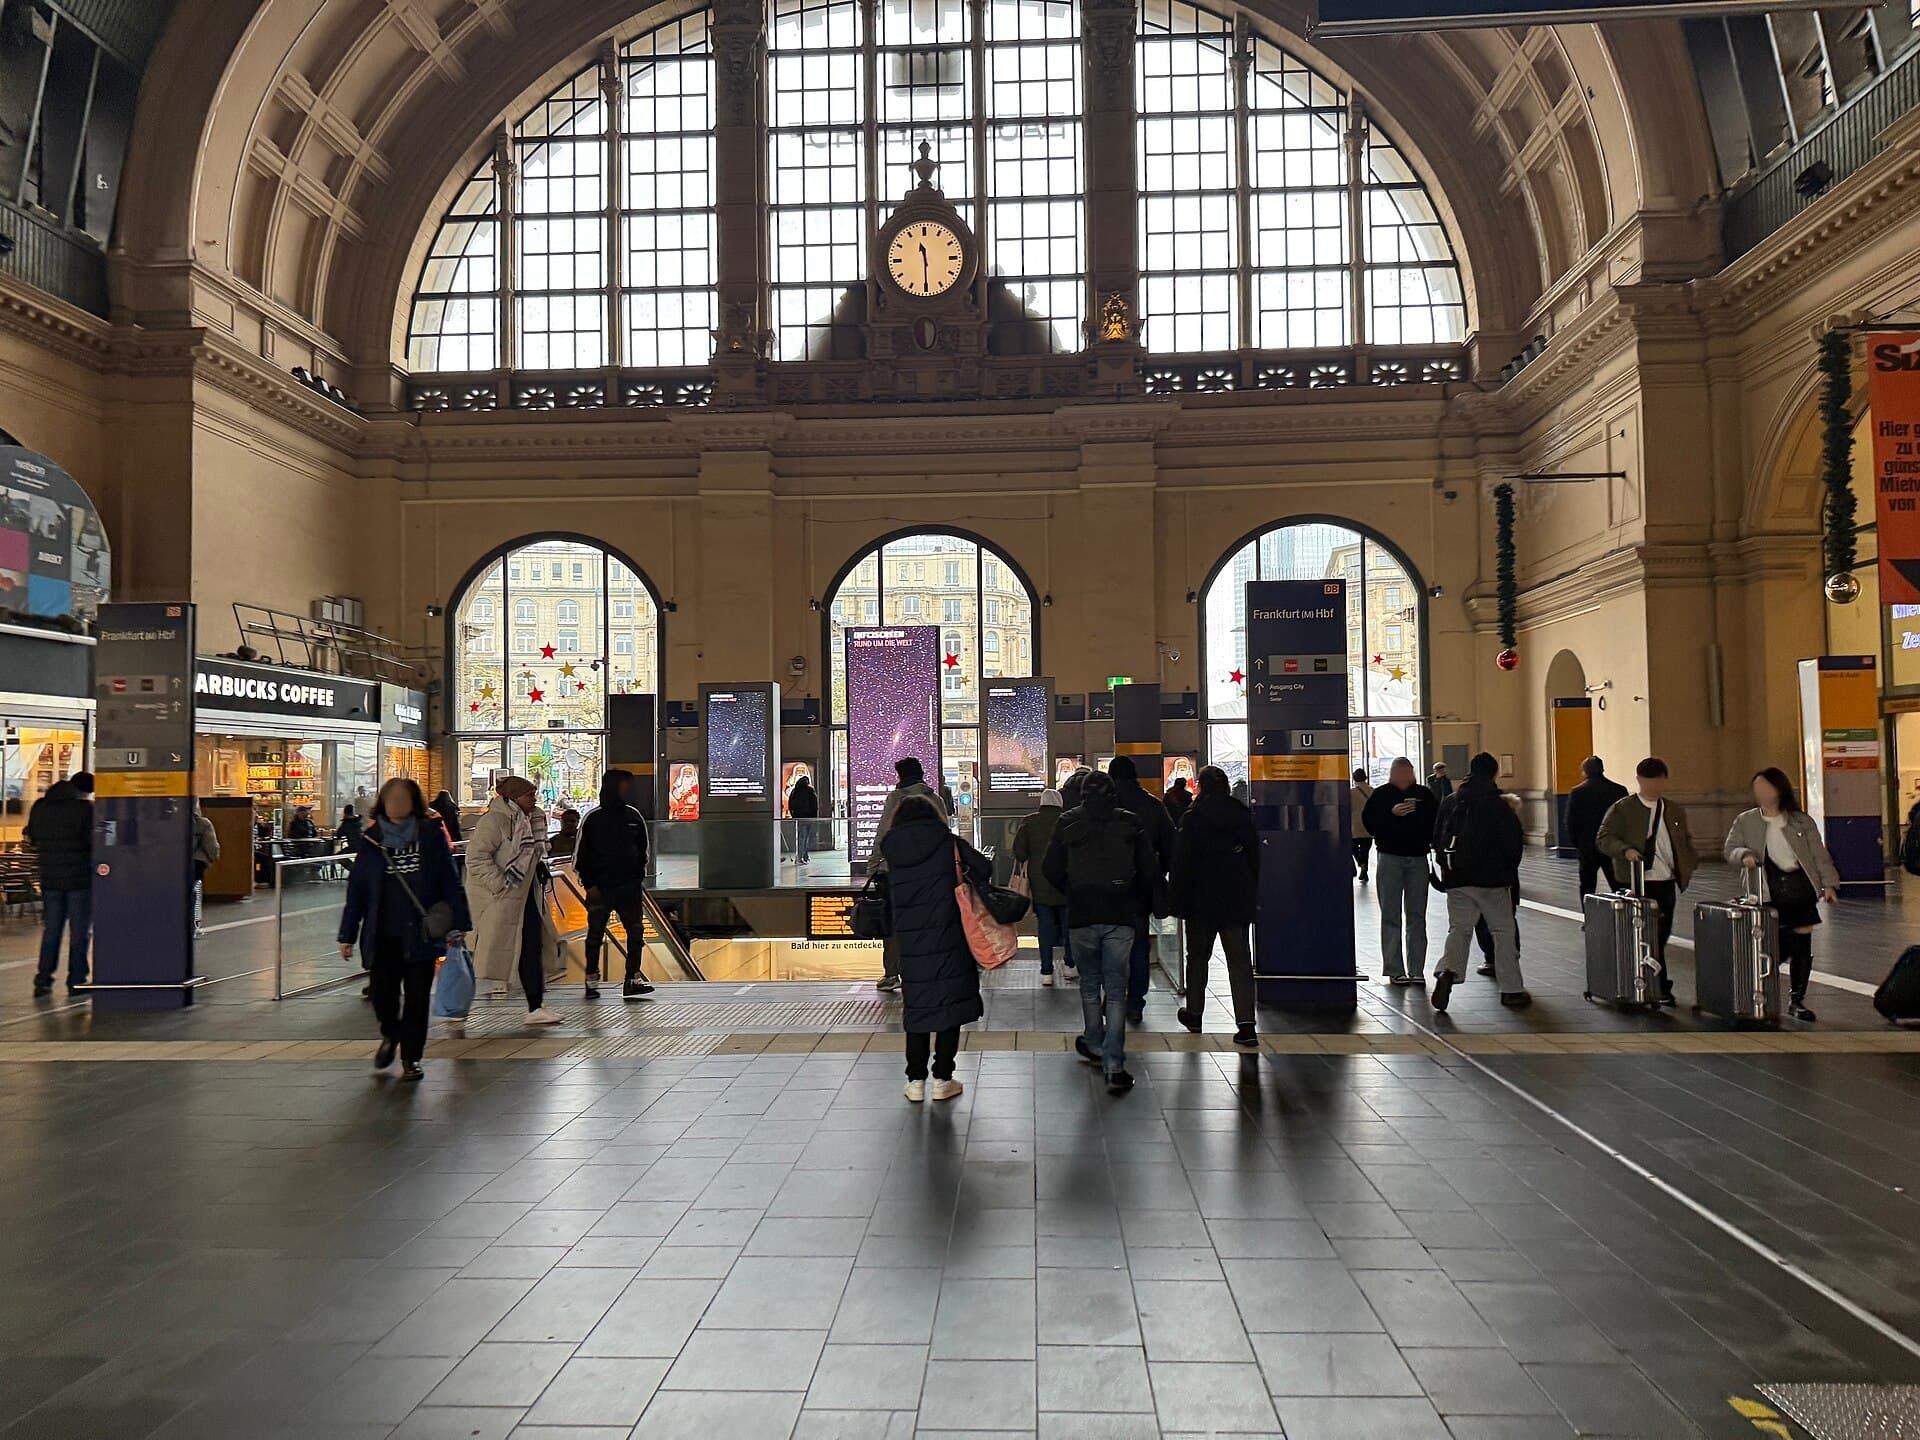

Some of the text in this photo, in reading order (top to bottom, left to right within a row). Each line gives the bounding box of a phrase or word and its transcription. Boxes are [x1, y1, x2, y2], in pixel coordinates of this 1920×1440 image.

[1879, 421, 1909, 437] Hier
[1896, 443, 1912, 455] zu
[1888, 498, 1916, 511] von
[1253, 608, 1334, 619] Frankfurt (M) Hbf
[854, 640, 872, 648] RUND
[885, 639, 895, 647] DIE
[896, 639, 913, 647] WELT
[194, 673, 335, 708] ARBUCKS COFFEE
[1302, 734, 1312, 746] U
[128, 752, 138, 764] U
[791, 942, 810, 950] Bald
[812, 942, 830, 950] hier
